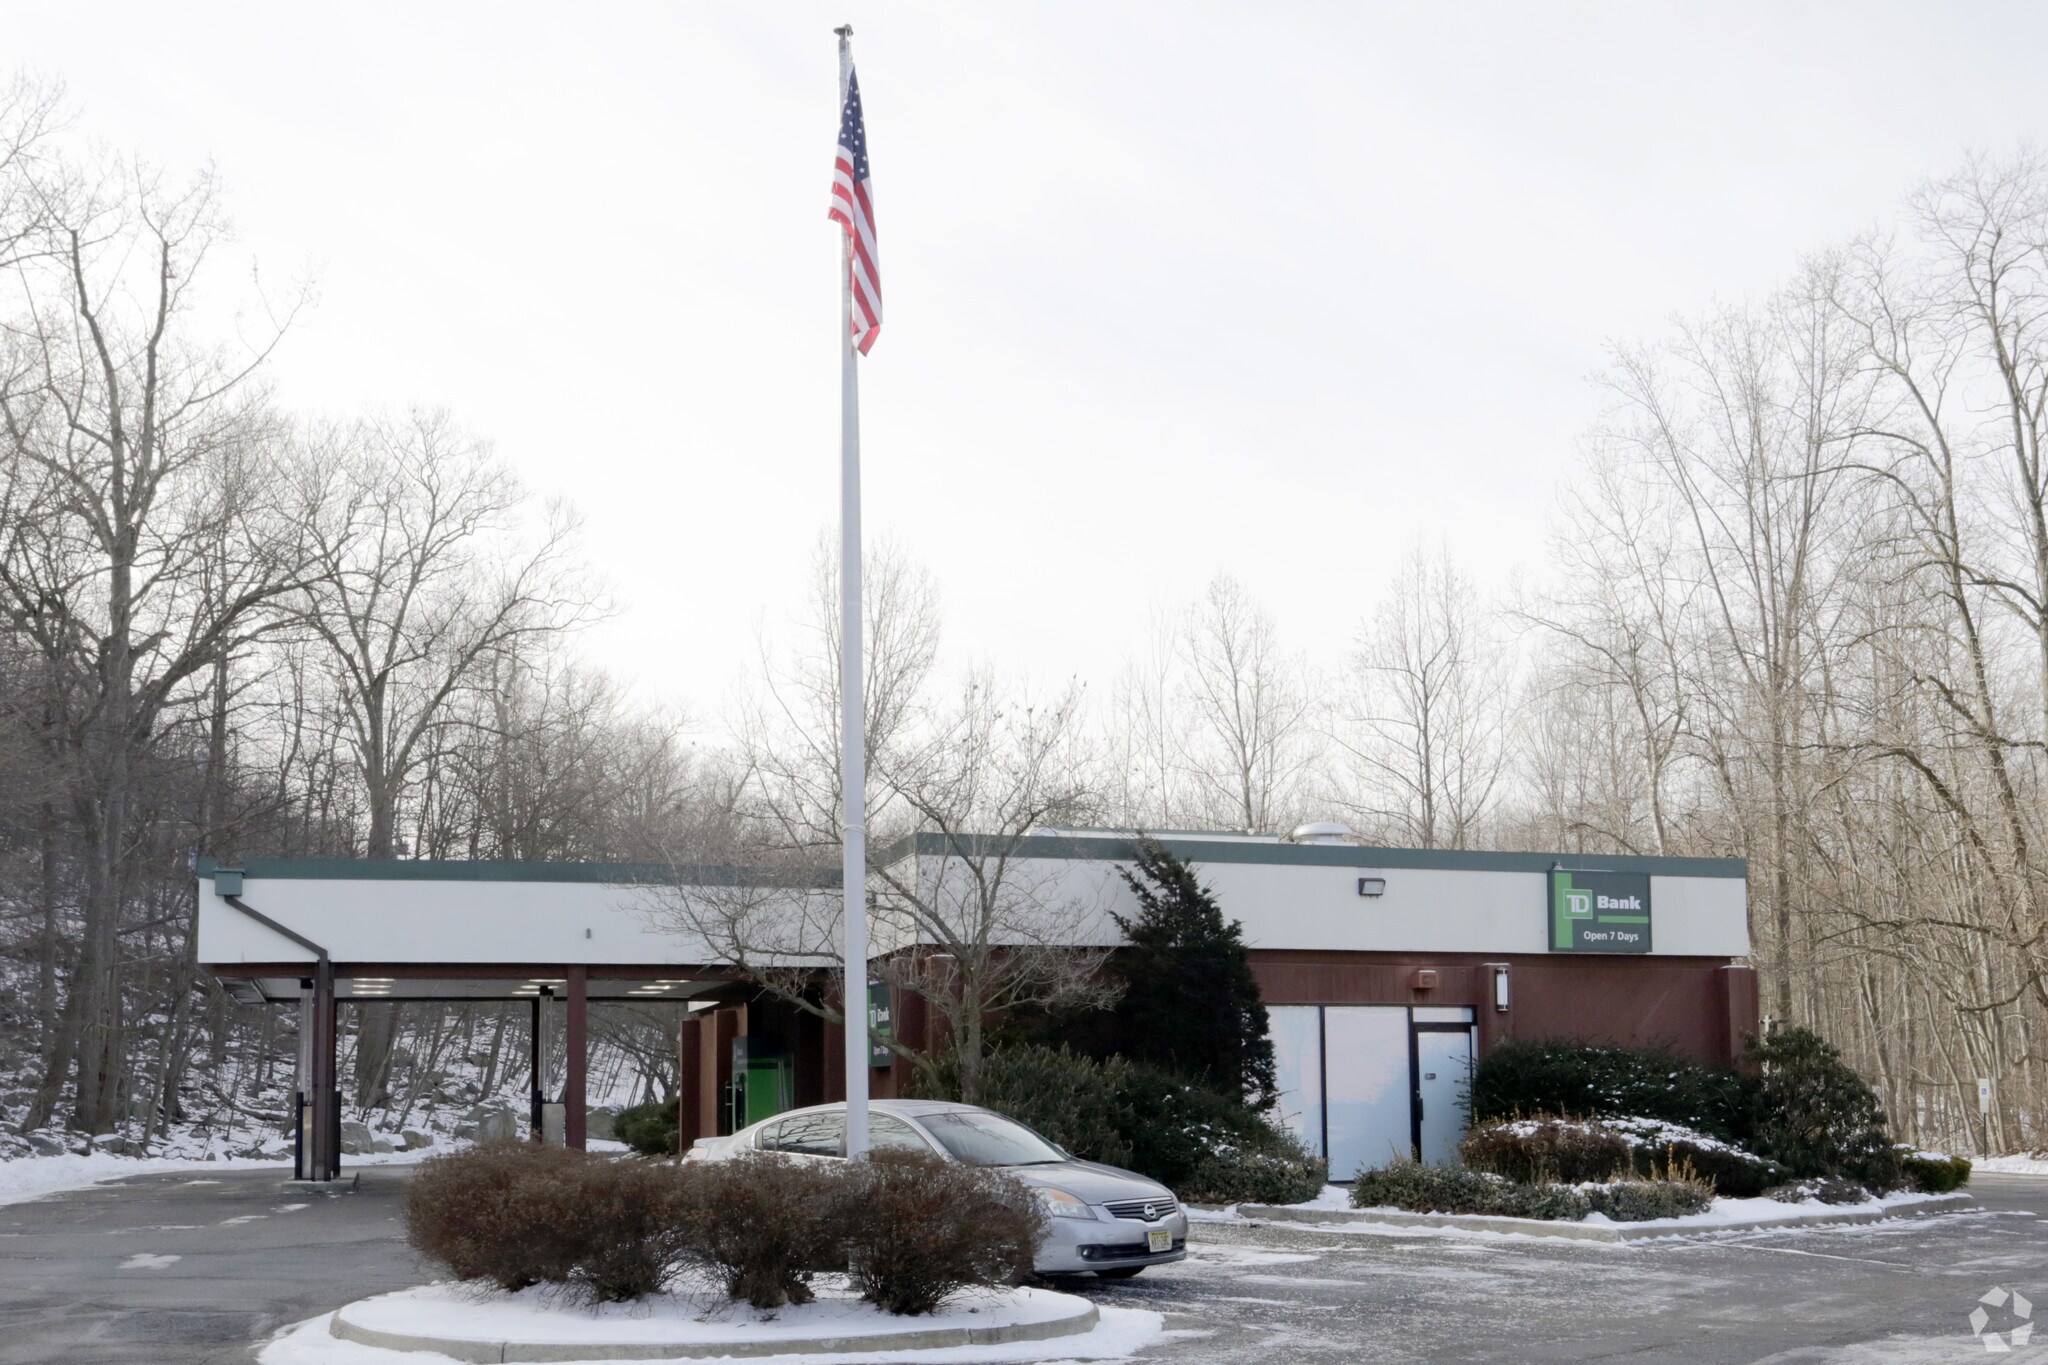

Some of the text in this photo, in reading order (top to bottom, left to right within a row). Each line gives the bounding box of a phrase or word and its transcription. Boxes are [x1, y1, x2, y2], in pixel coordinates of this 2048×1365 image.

[1566, 894, 1641, 913] TD Bank
[1583, 931, 1639, 943] Open 7 Days
